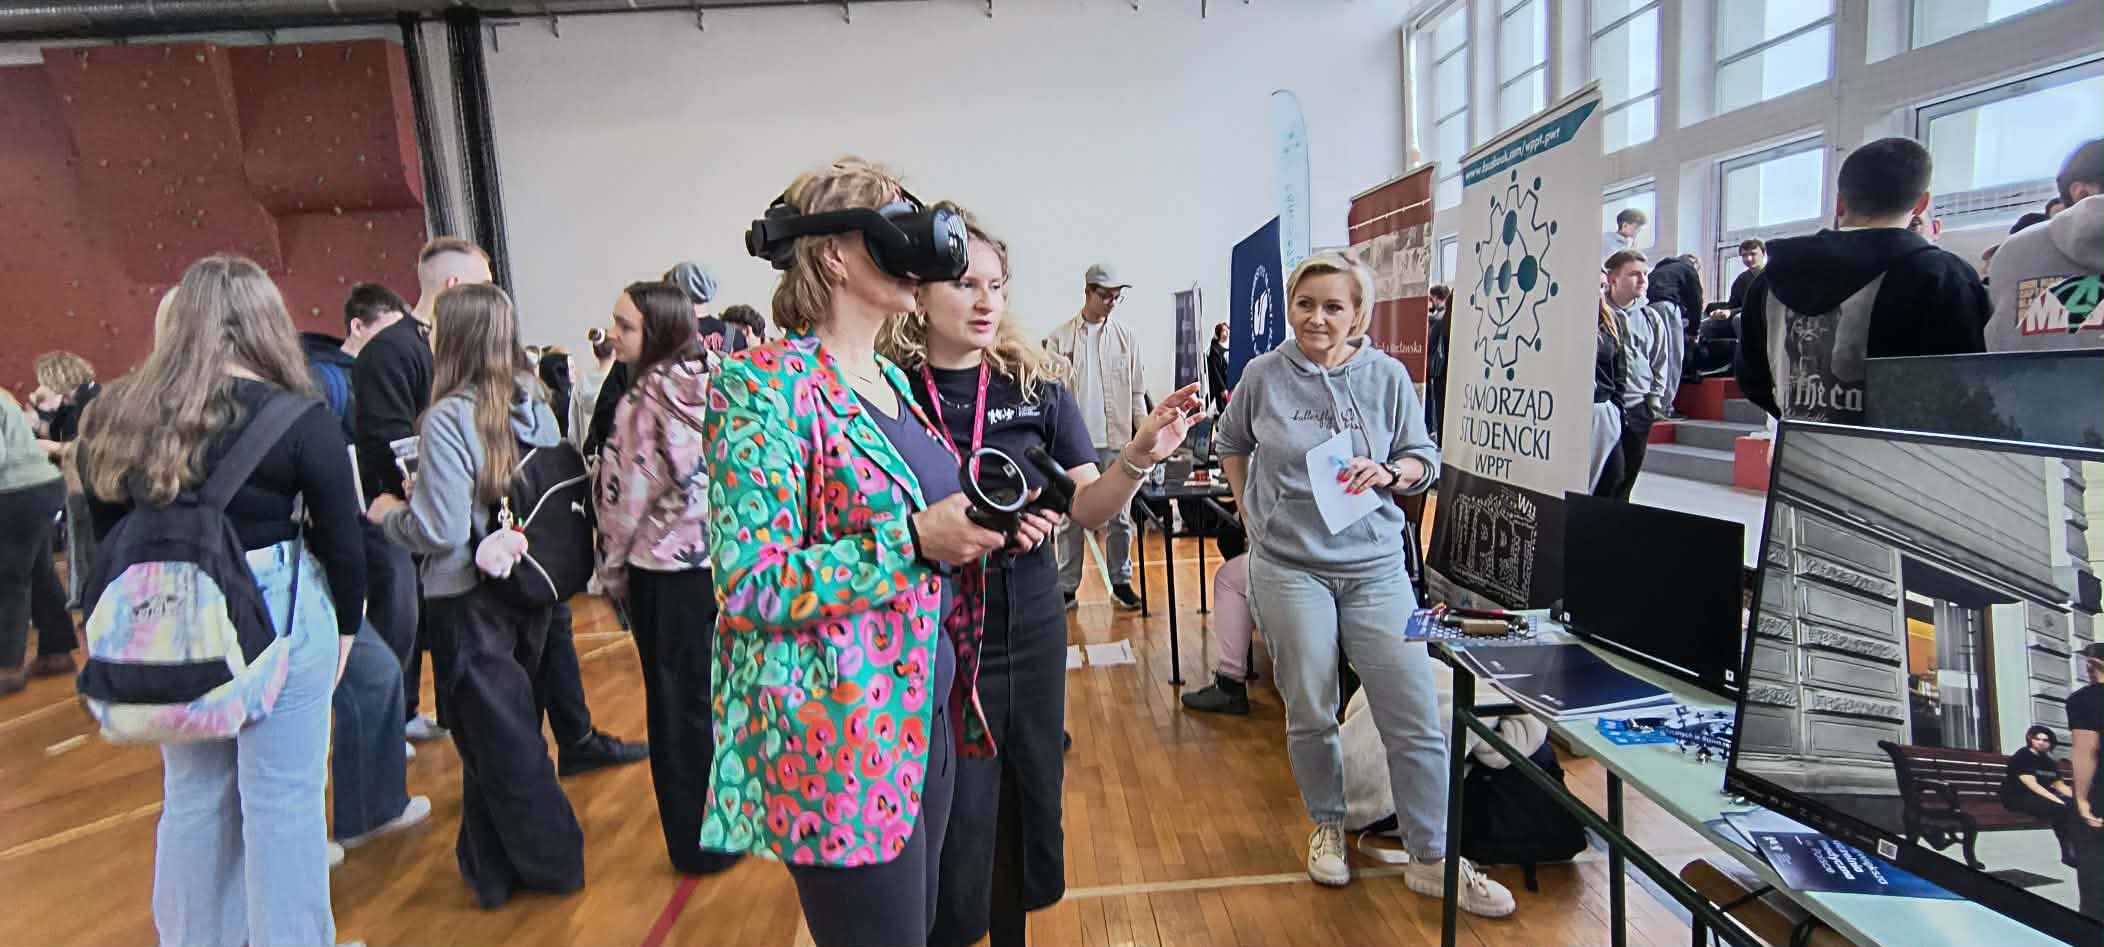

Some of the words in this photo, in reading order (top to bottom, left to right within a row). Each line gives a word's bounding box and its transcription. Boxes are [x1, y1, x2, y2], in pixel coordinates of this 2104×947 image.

[1463, 383, 1554, 425] SAMORZĄD
[1459, 416, 1551, 460] STUDENCKI
[1475, 453, 1512, 479] WPPT
